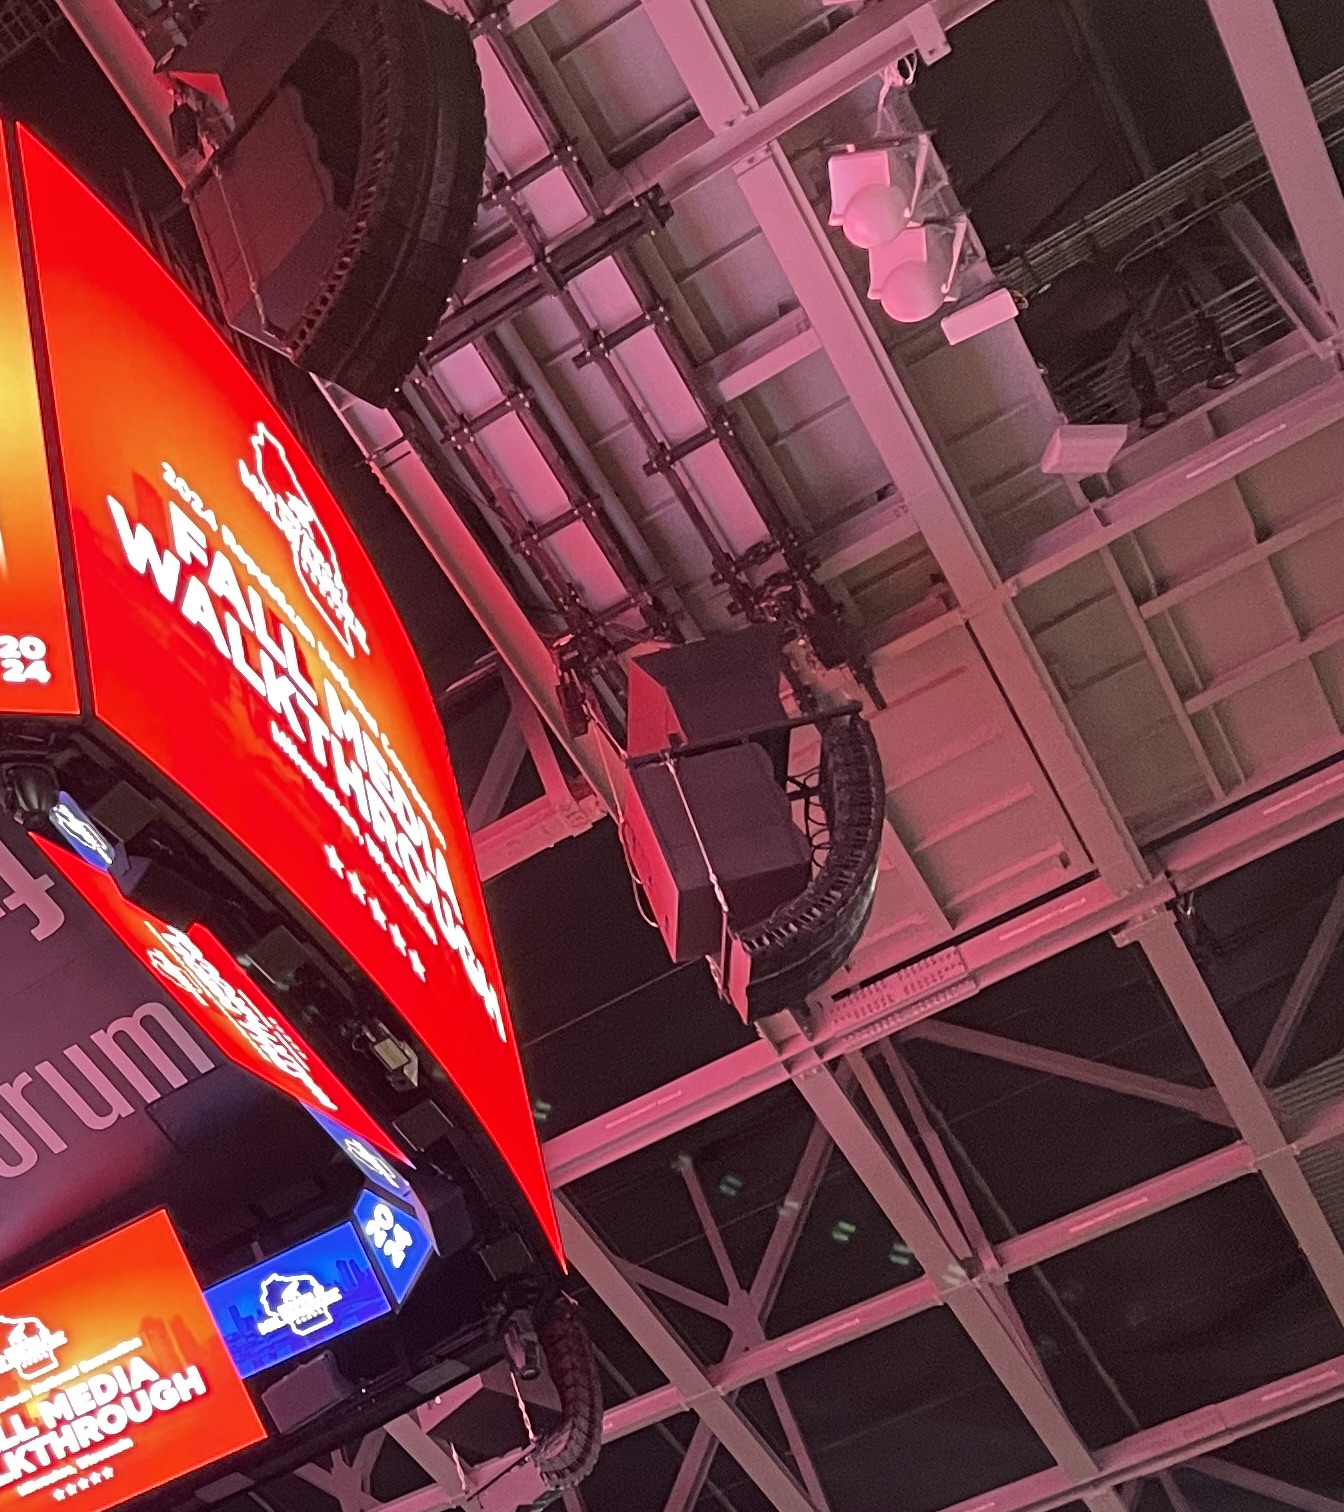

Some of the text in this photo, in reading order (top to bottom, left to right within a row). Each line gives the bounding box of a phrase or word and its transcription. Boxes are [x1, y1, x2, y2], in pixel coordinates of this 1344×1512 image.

[1, 659, 52, 684] 24
[107, 495, 507, 1043] WALKTHROUGH
[169, 501, 318, 706] FALL
[324, 678, 463, 925] MEDIA
[38, 1356, 160, 1430] MEDIA
